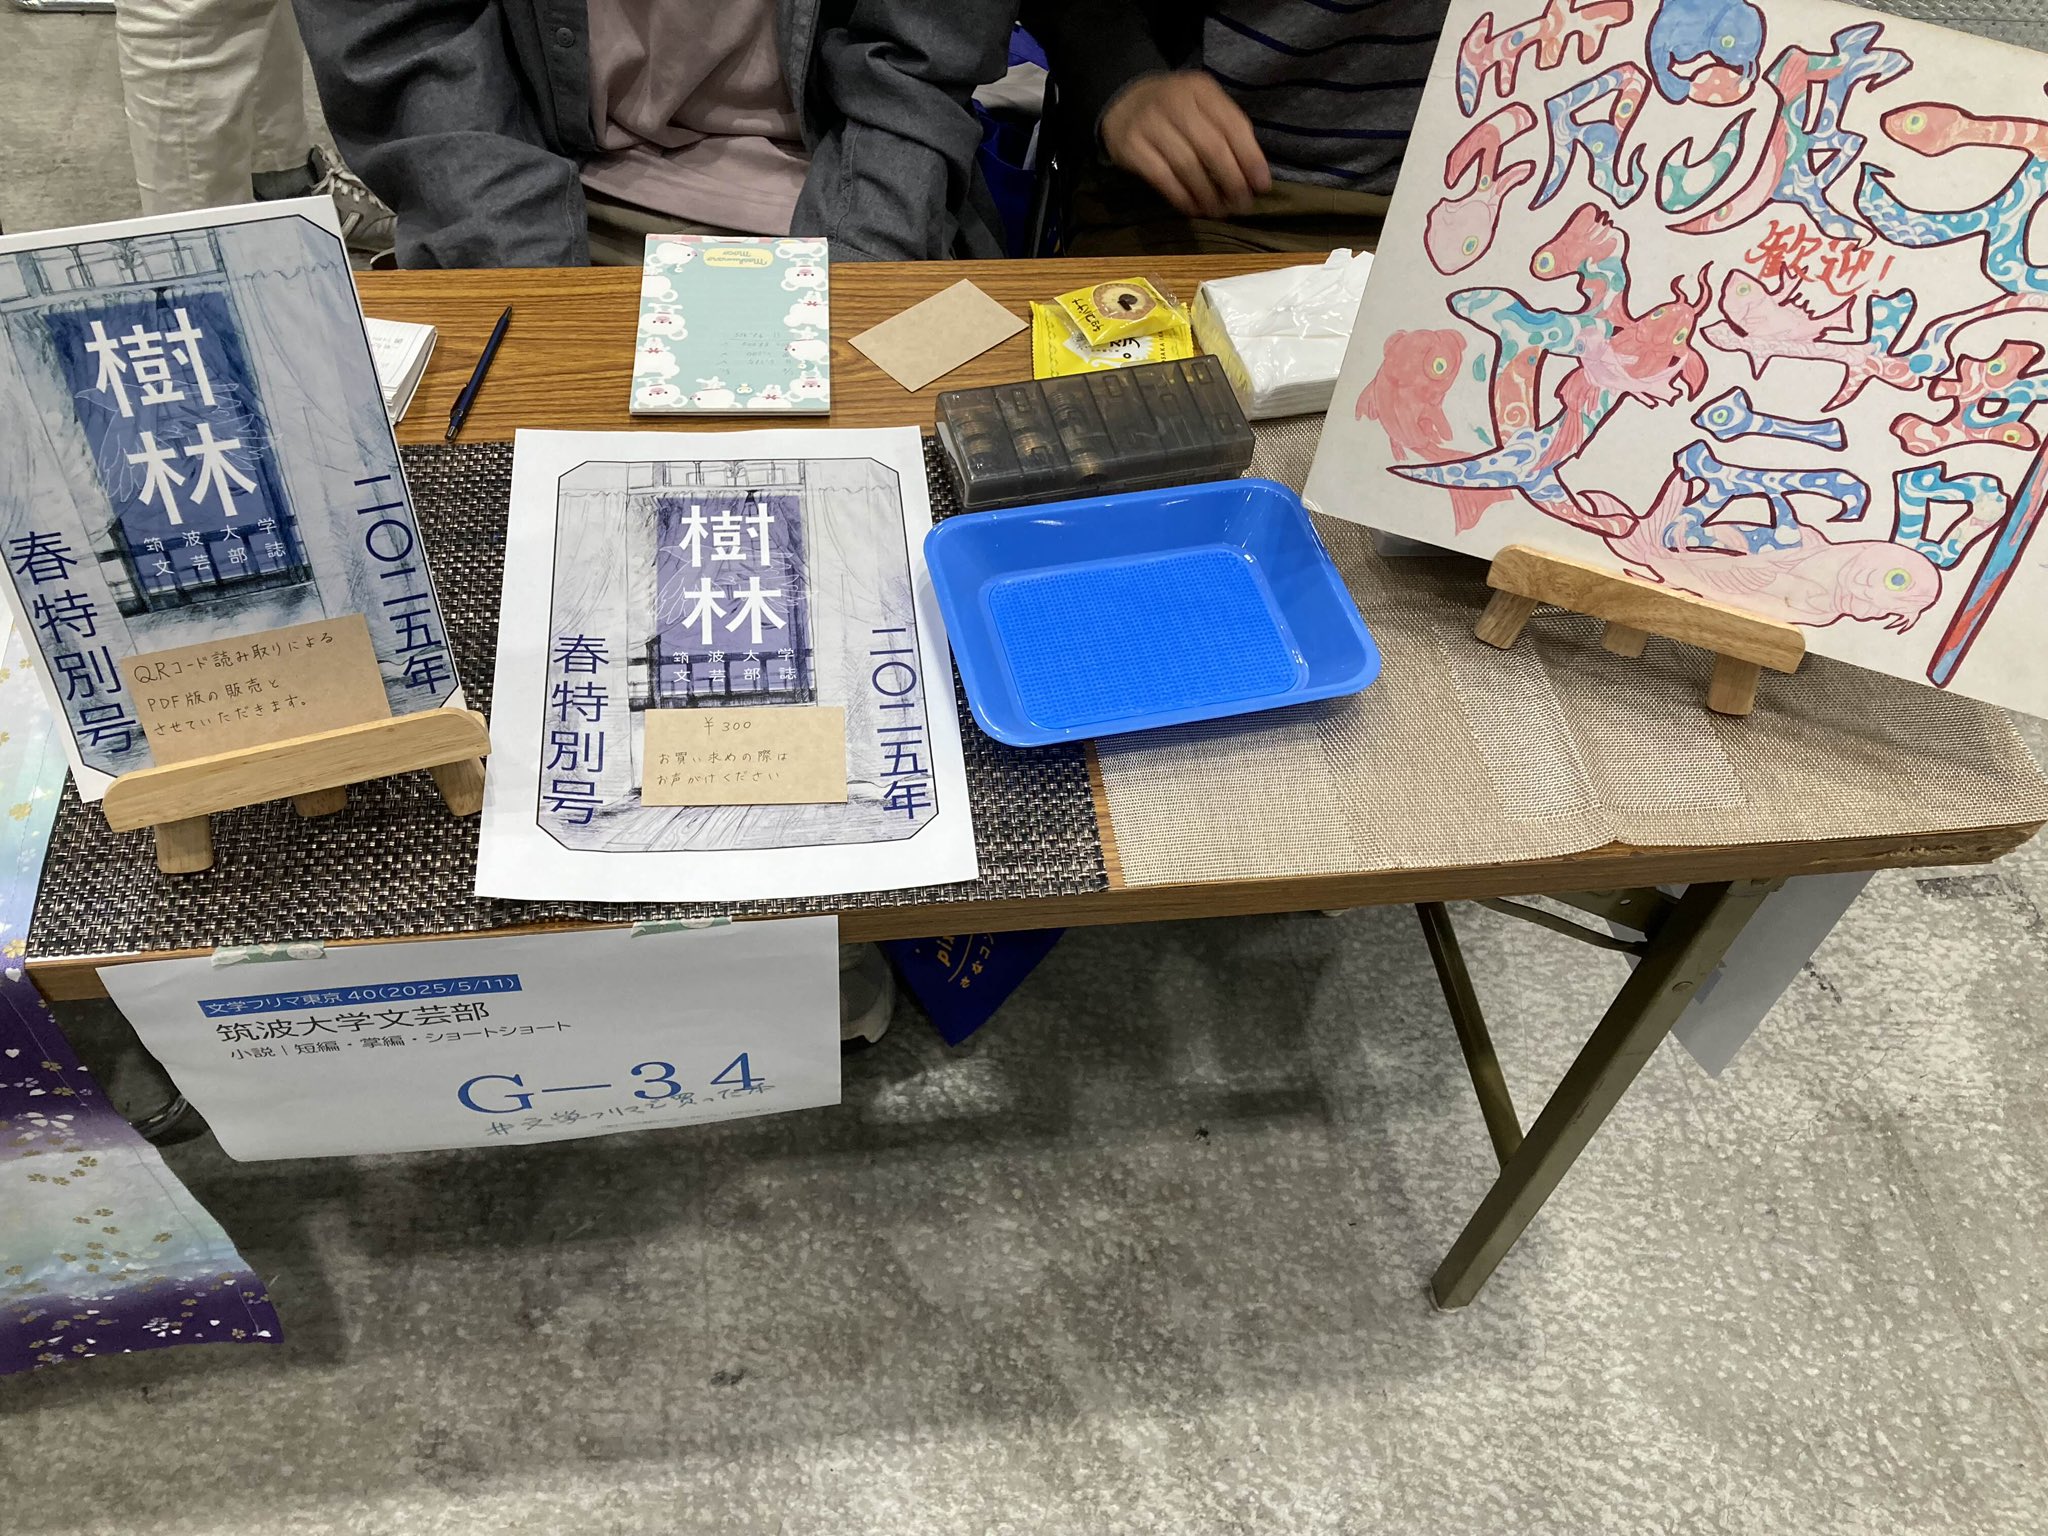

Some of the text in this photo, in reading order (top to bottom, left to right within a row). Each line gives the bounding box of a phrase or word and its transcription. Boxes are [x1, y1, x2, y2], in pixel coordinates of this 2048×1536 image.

[85, 307, 258, 526] 樹林
[143, 517, 277, 553] 筑波大学
[152, 541, 286, 577] 文芸部誌
[678, 502, 788, 646] 樹林
[9, 530, 137, 755] 春特別号
[133, 632, 334, 684] QRコード読み取りによる
[672, 647, 796, 665] 筑波大学
[673, 666, 798, 683] 文芸部誌
[154, 695, 307, 736] させていただきます。
[542, 634, 611, 826] 春特別号
[658, 749, 789, 765] お買い求めの際は
[656, 770, 781, 787] お声がけください
[204, 990, 344, 1015] 文学フリマ東京
[215, 1001, 490, 1043] 筑波大学文芸部
